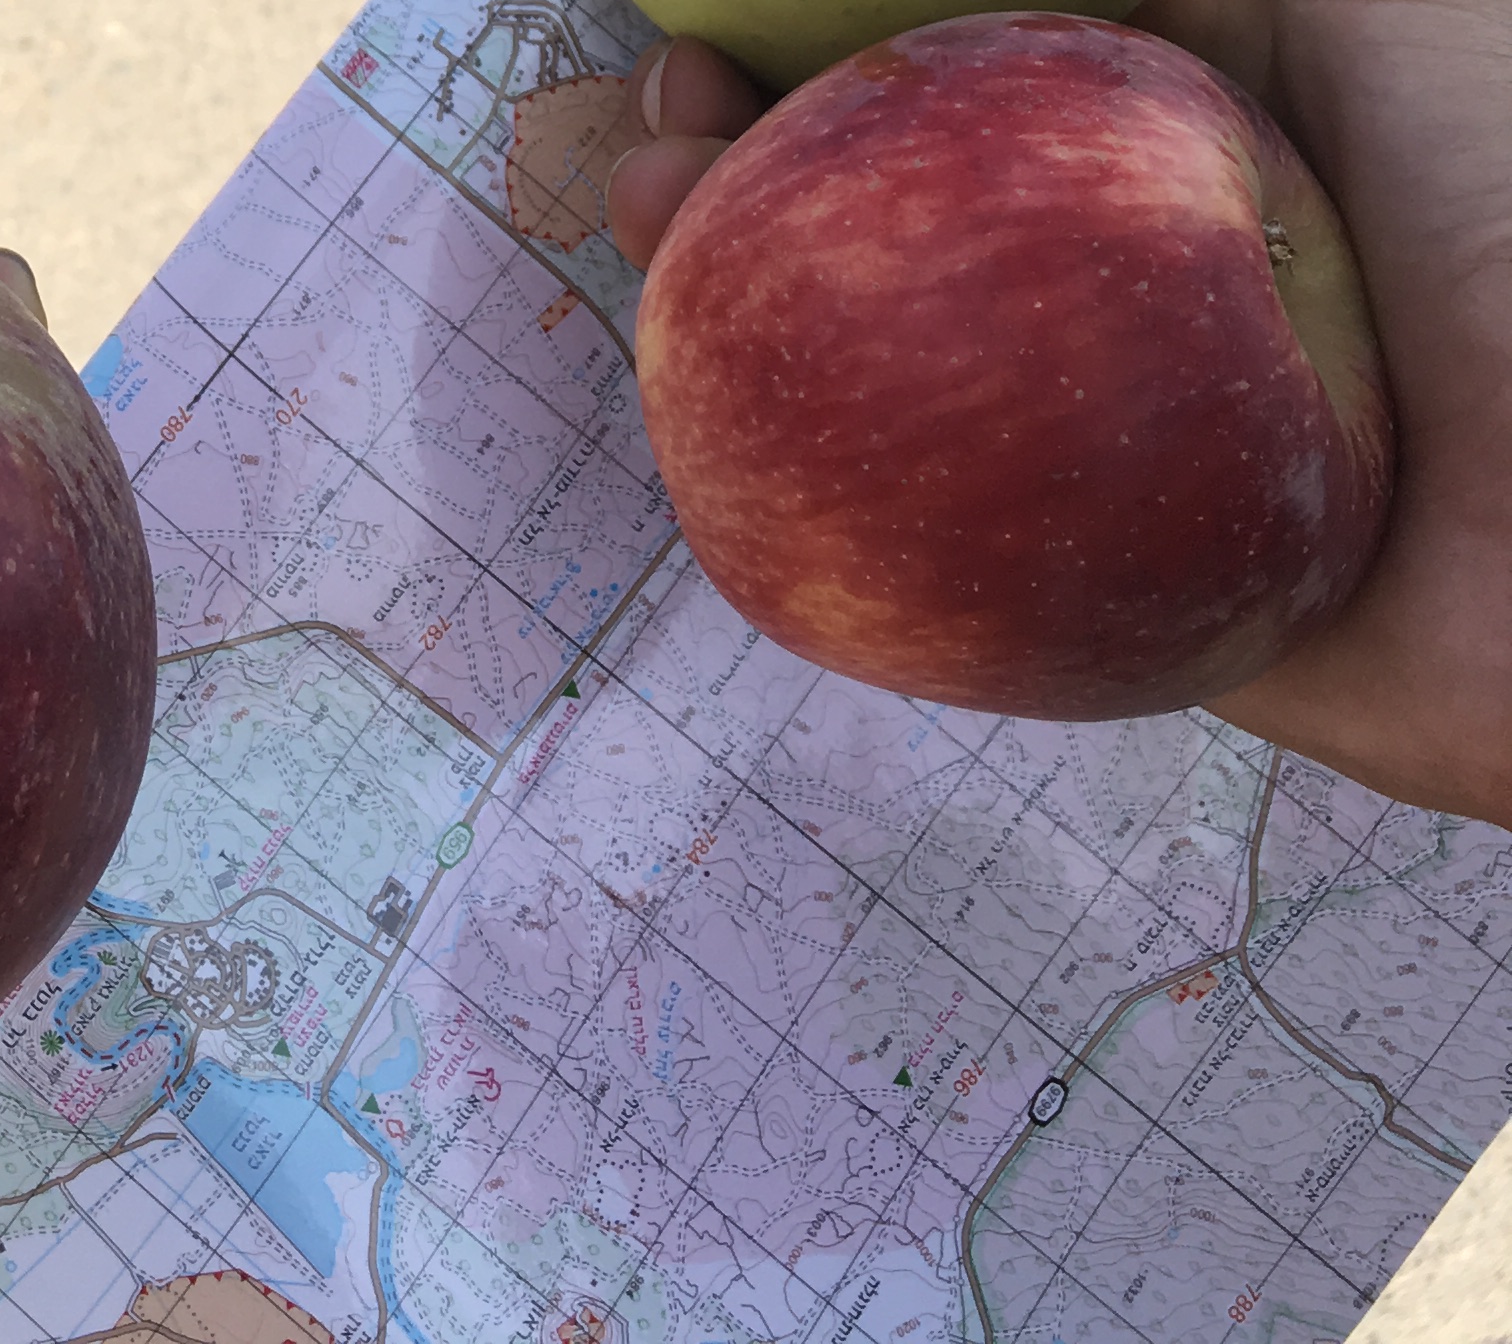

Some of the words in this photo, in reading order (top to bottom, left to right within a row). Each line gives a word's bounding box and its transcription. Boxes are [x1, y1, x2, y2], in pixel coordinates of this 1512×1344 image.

[155, 403, 194, 445] 780
[271, 385, 310, 428] 270
[515, 519, 544, 550] תל
[415, 612, 453, 654] 782
[455, 754, 488, 790] צומת
[440, 829, 469, 861] 959
[681, 825, 720, 867] 784
[258, 924, 341, 1020] מרום-גולן
[341, 962, 375, 1000] צומת
[0, 1021, 27, 1051] הר
[19, 977, 63, 1026] בנטל
[65, 996, 103, 1037] פארק
[289, 1002, 331, 1049] תצפית
[115, 1035, 156, 1080] 1231
[403, 1044, 446, 1093] ברכת
[429, 1035, 479, 1092] שמורת
[949, 1056, 988, 1099] 786
[64, 1081, 106, 1128] מסלול
[172, 1075, 213, 1122] מחסום
[1031, 1083, 1064, 1119] 9799
[227, 1109, 270, 1156] בנטל
[243, 1126, 284, 1173] מאגר
[1119, 1271, 1149, 1305] 1032
[1223, 1282, 1264, 1326] 788
